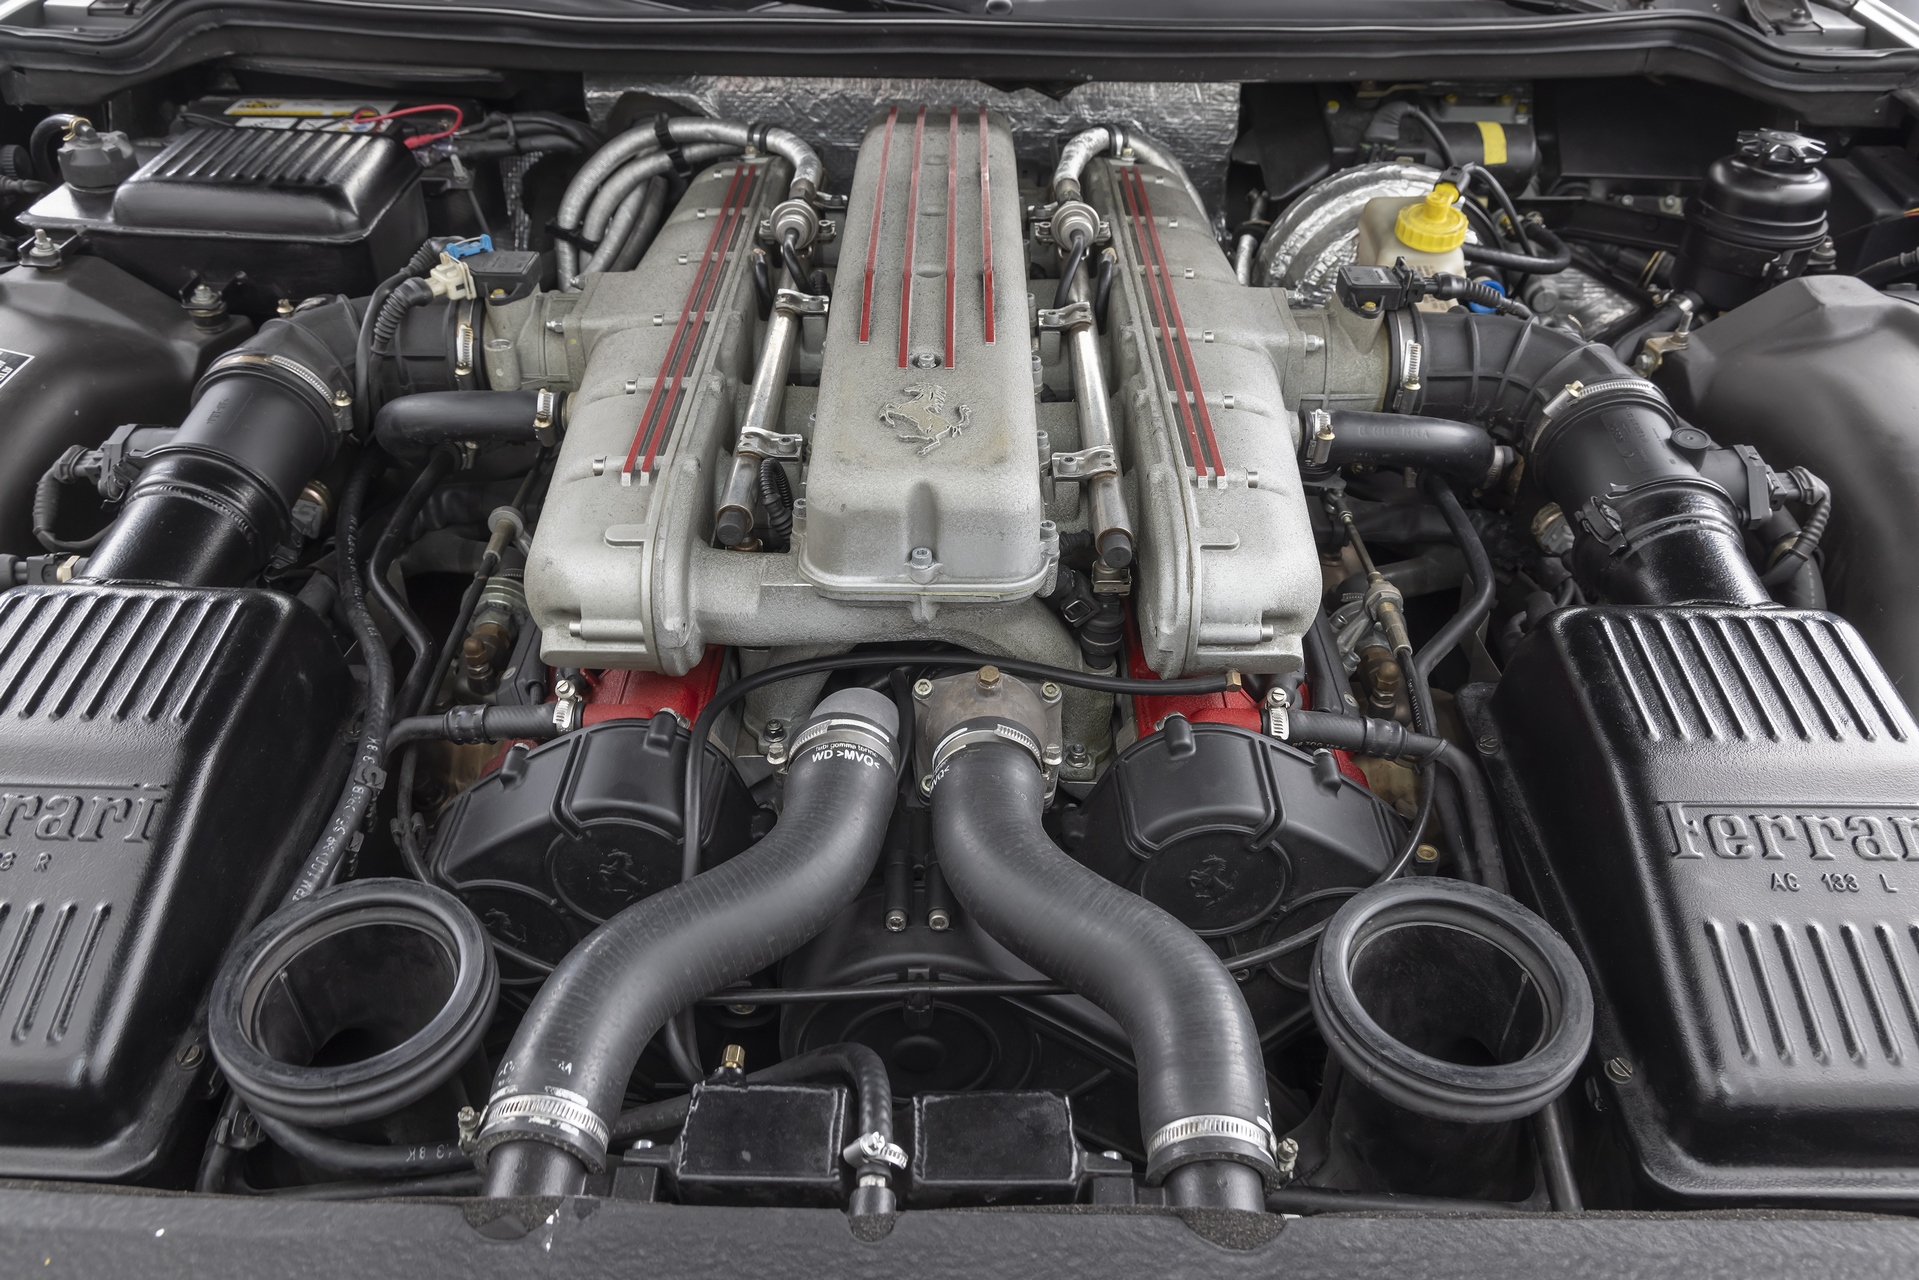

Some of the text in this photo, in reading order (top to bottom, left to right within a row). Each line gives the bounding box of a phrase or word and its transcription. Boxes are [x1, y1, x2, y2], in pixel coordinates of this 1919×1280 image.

[812, 749, 833, 762] WD
[34, 851, 52, 872] R
[1771, 871, 1800, 892] AC
[1879, 872, 1898, 893] L
